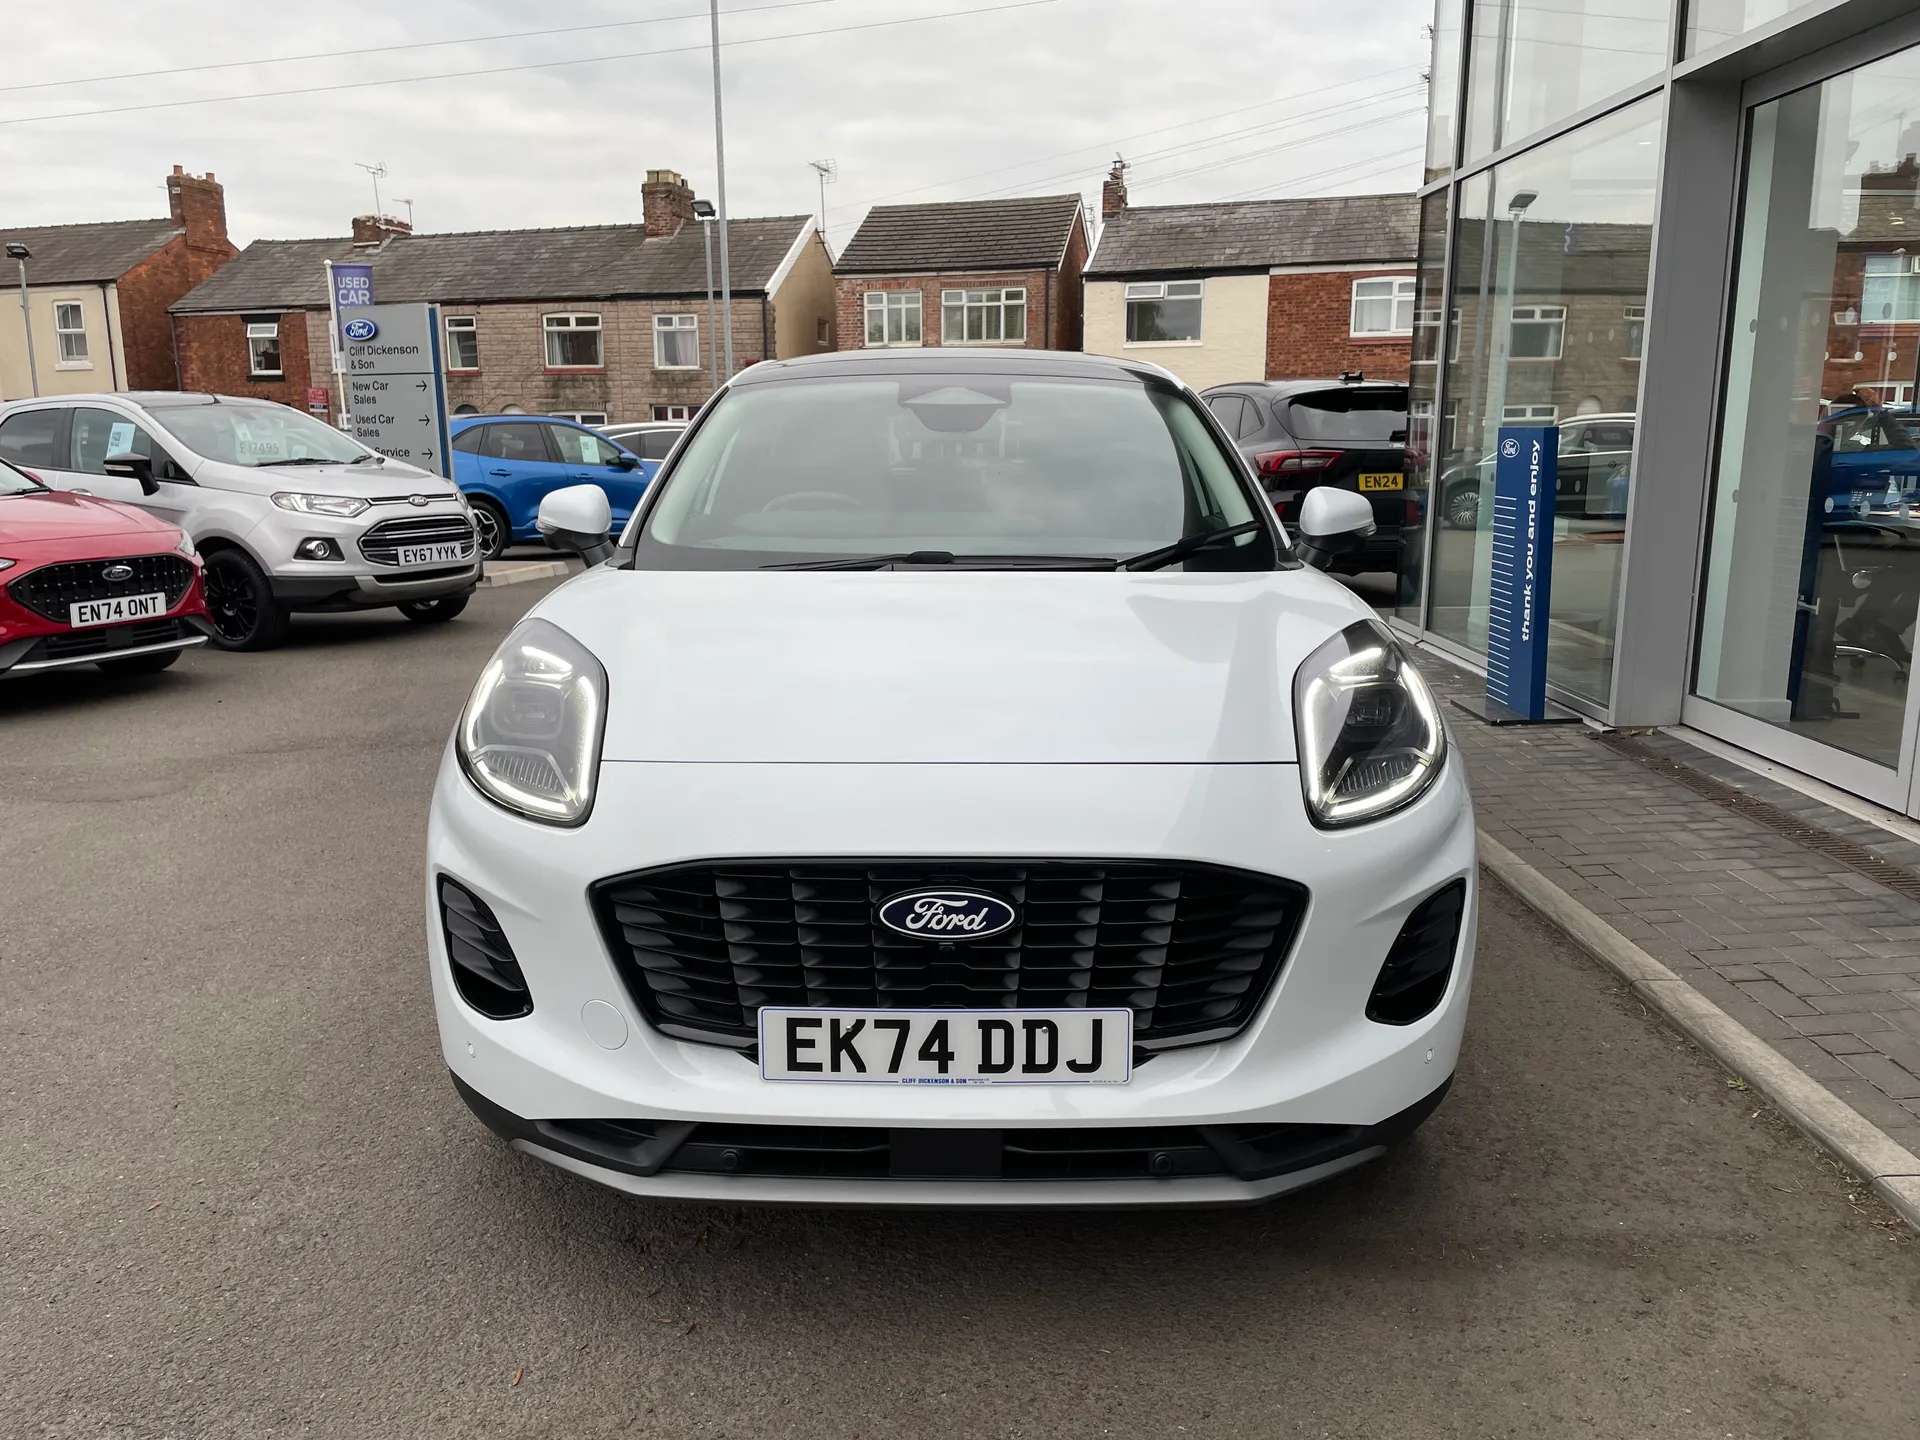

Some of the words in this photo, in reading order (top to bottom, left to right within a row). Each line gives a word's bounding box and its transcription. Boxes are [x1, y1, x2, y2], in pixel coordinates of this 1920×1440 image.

[337, 276, 370, 289] USED
[338, 290, 370, 305] CAR
[349, 345, 365, 356] Cliff
[367, 345, 419, 356] Dickenson
[350, 360, 356, 370] &
[357, 359, 375, 370] Son
[352, 381, 370, 392] New
[372, 380, 389, 391] Car
[353, 394, 377, 405] Sales
[355, 414, 377, 425] Used
[378, 414, 395, 425] Car
[357, 427, 380, 438] Sales
[1529, 439, 1541, 496] enjoy
[1364, 474, 1399, 488] EN24
[1527, 500, 1536, 540] and
[403, 547, 433, 563] EY67
[436, 545, 458, 560] YYK
[1525, 543, 1534, 580] you
[78, 600, 123, 623] EN74
[128, 596, 158, 616] ONT
[1521, 583, 1532, 642] thank
[905, 898, 989, 931] Ford
[786, 1017, 955, 1074] EK74
[977, 1018, 1103, 1074] DDJ
